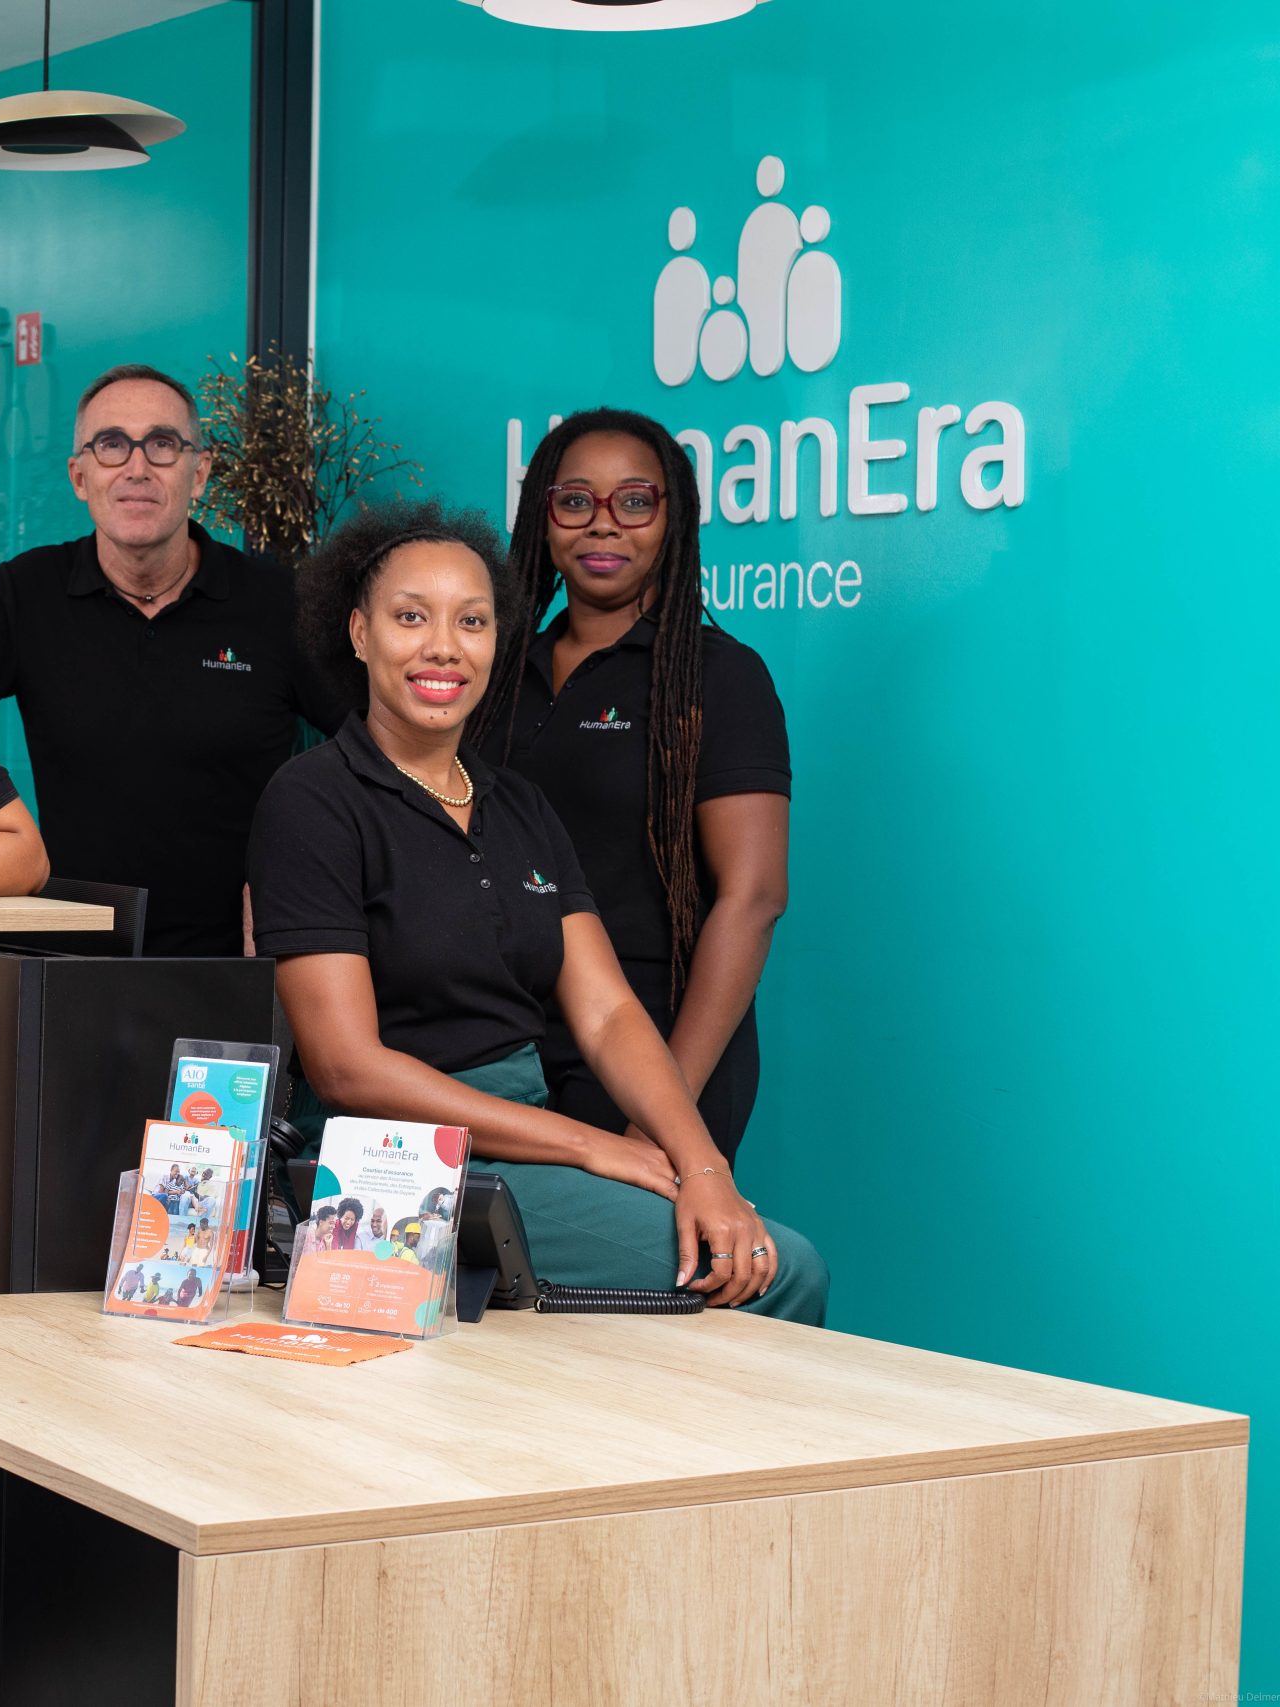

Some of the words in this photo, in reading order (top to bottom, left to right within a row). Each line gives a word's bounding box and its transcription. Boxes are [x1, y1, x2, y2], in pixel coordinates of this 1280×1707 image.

[202, 659, 252, 671] HumanEra
[579, 720, 631, 730] HumanEra
[169, 1142, 210, 1154] HumanEra
[363, 1146, 419, 1161] HumanEra
